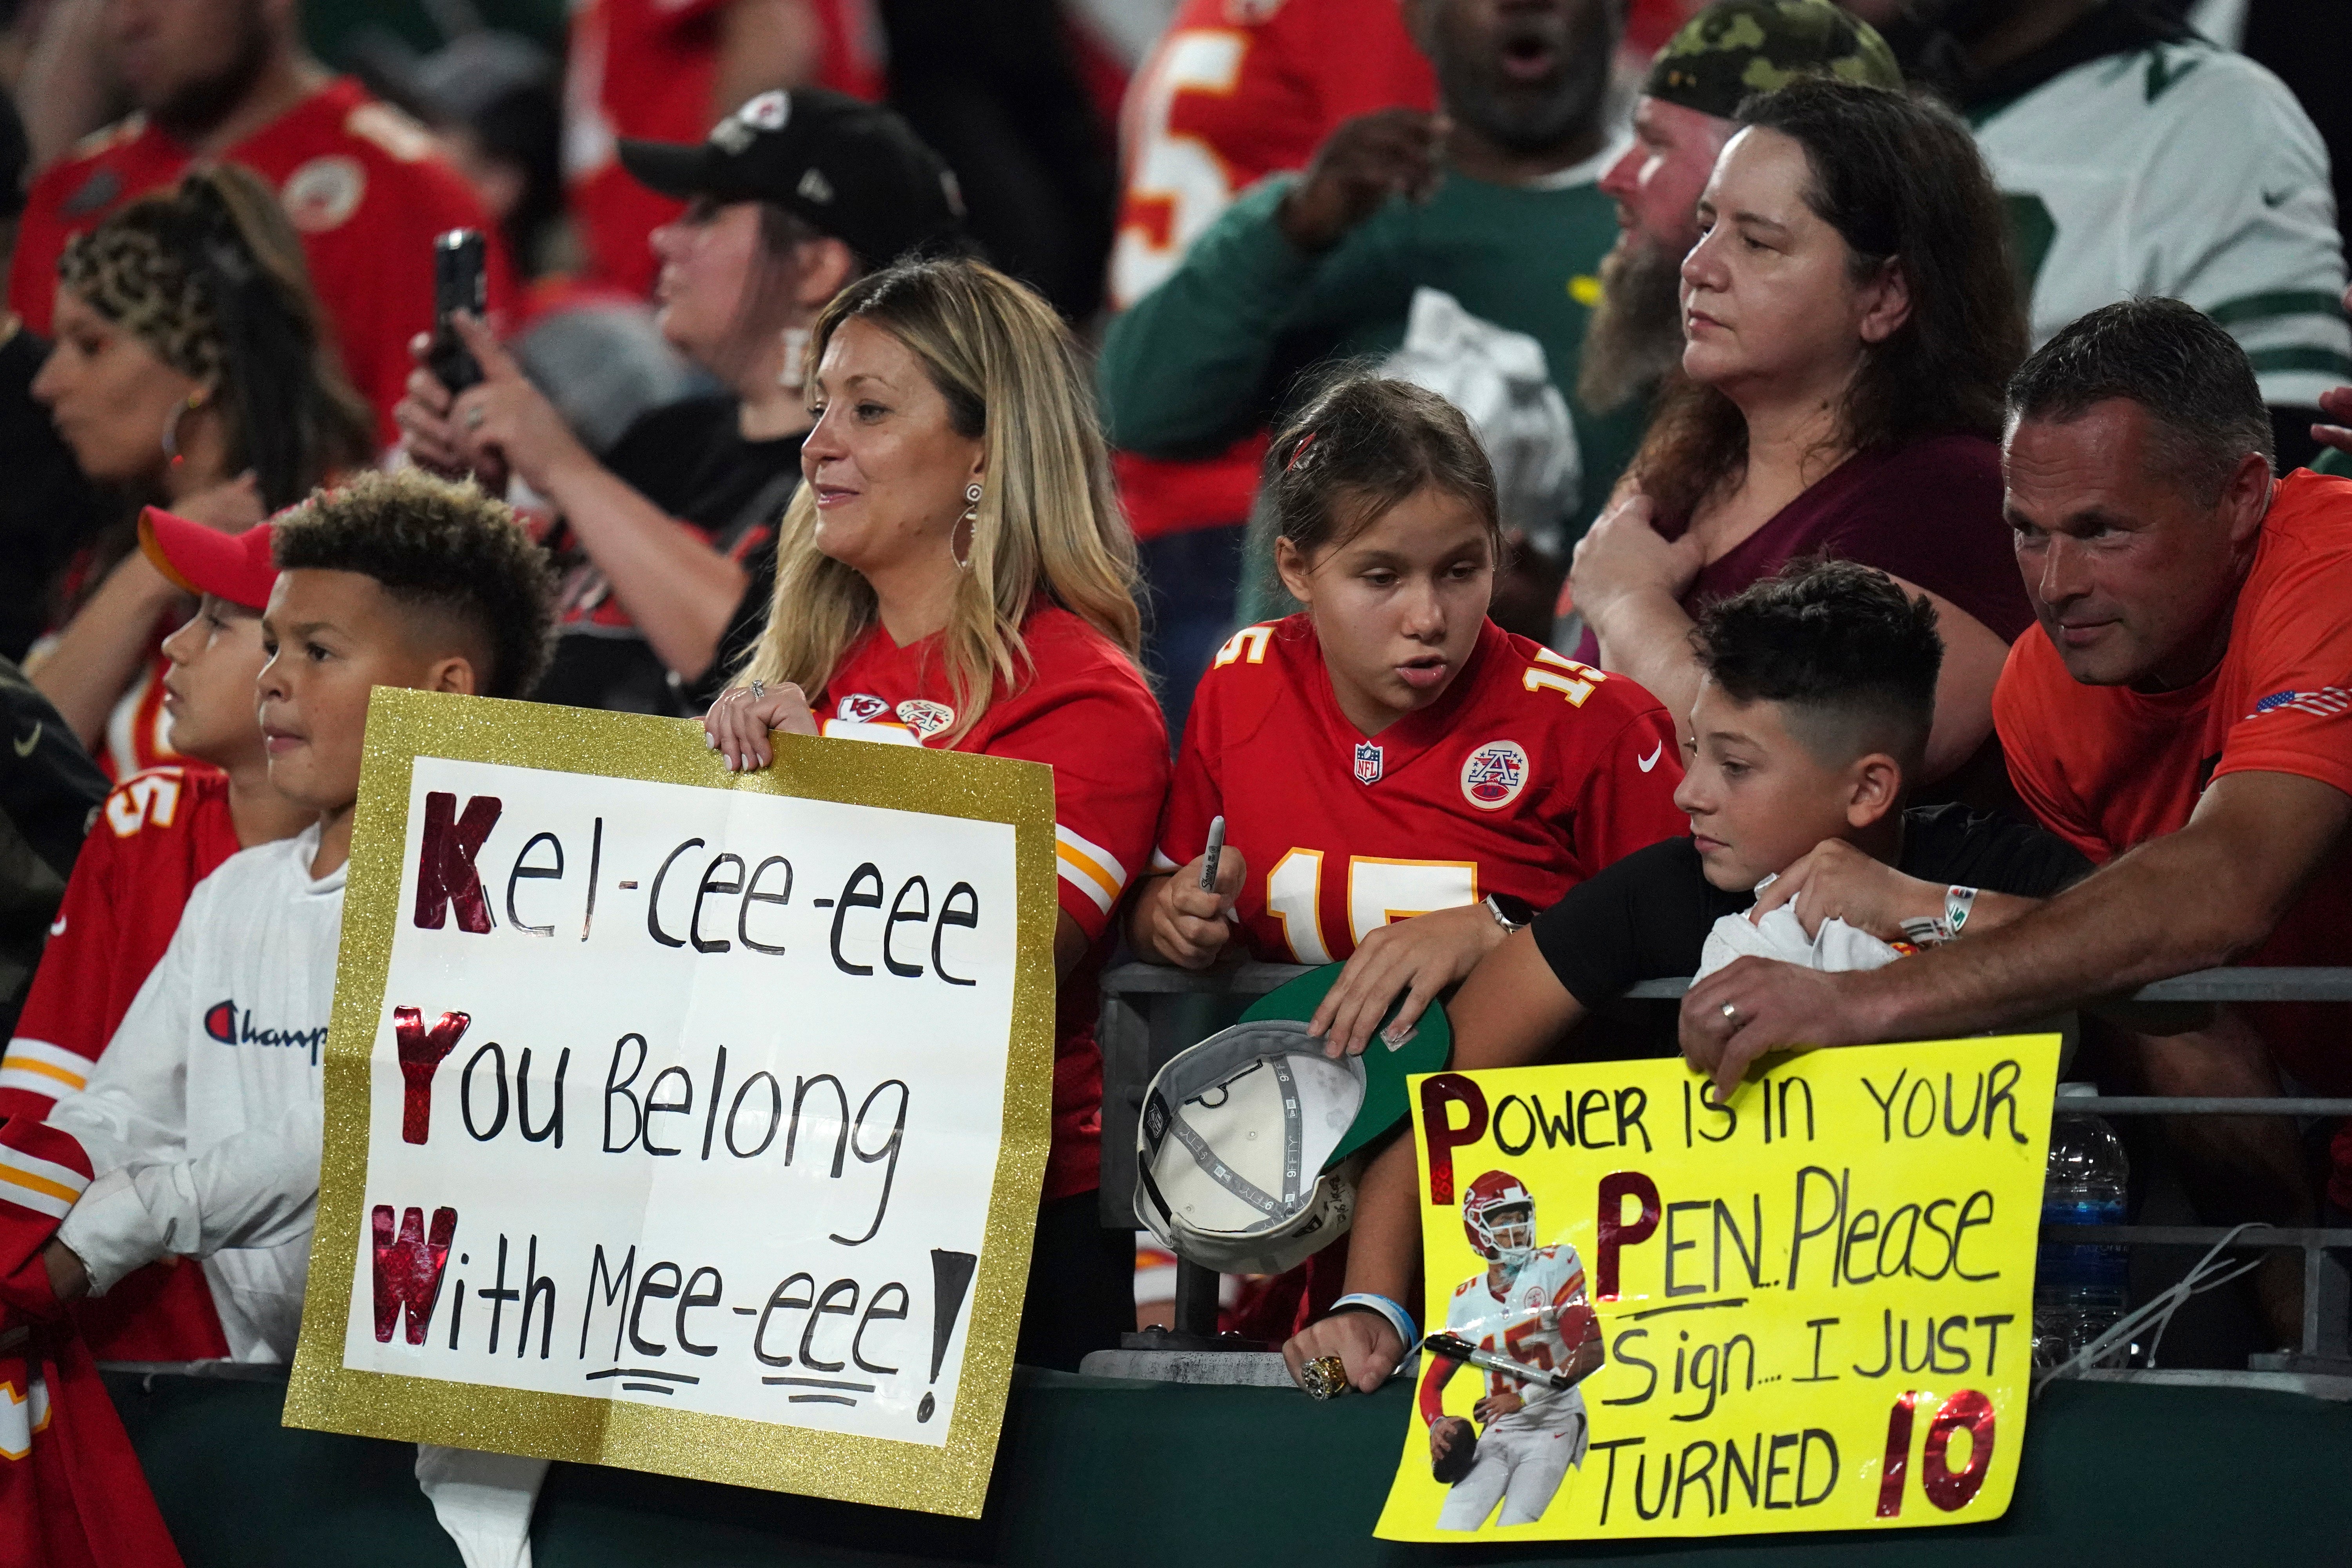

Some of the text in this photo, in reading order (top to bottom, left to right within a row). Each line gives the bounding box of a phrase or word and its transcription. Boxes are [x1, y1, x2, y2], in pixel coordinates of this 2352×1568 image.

[1357, 760, 1377, 777] NFL
[393, 1005, 911, 1247] You Belong
[1860, 1059, 2029, 1145] YOUR
[371, 1204, 554, 1360] With
[1791, 1318, 1840, 1382] I
[1852, 1308, 2015, 1378] JUST
[1589, 1388, 1998, 1526] TURNED 10
